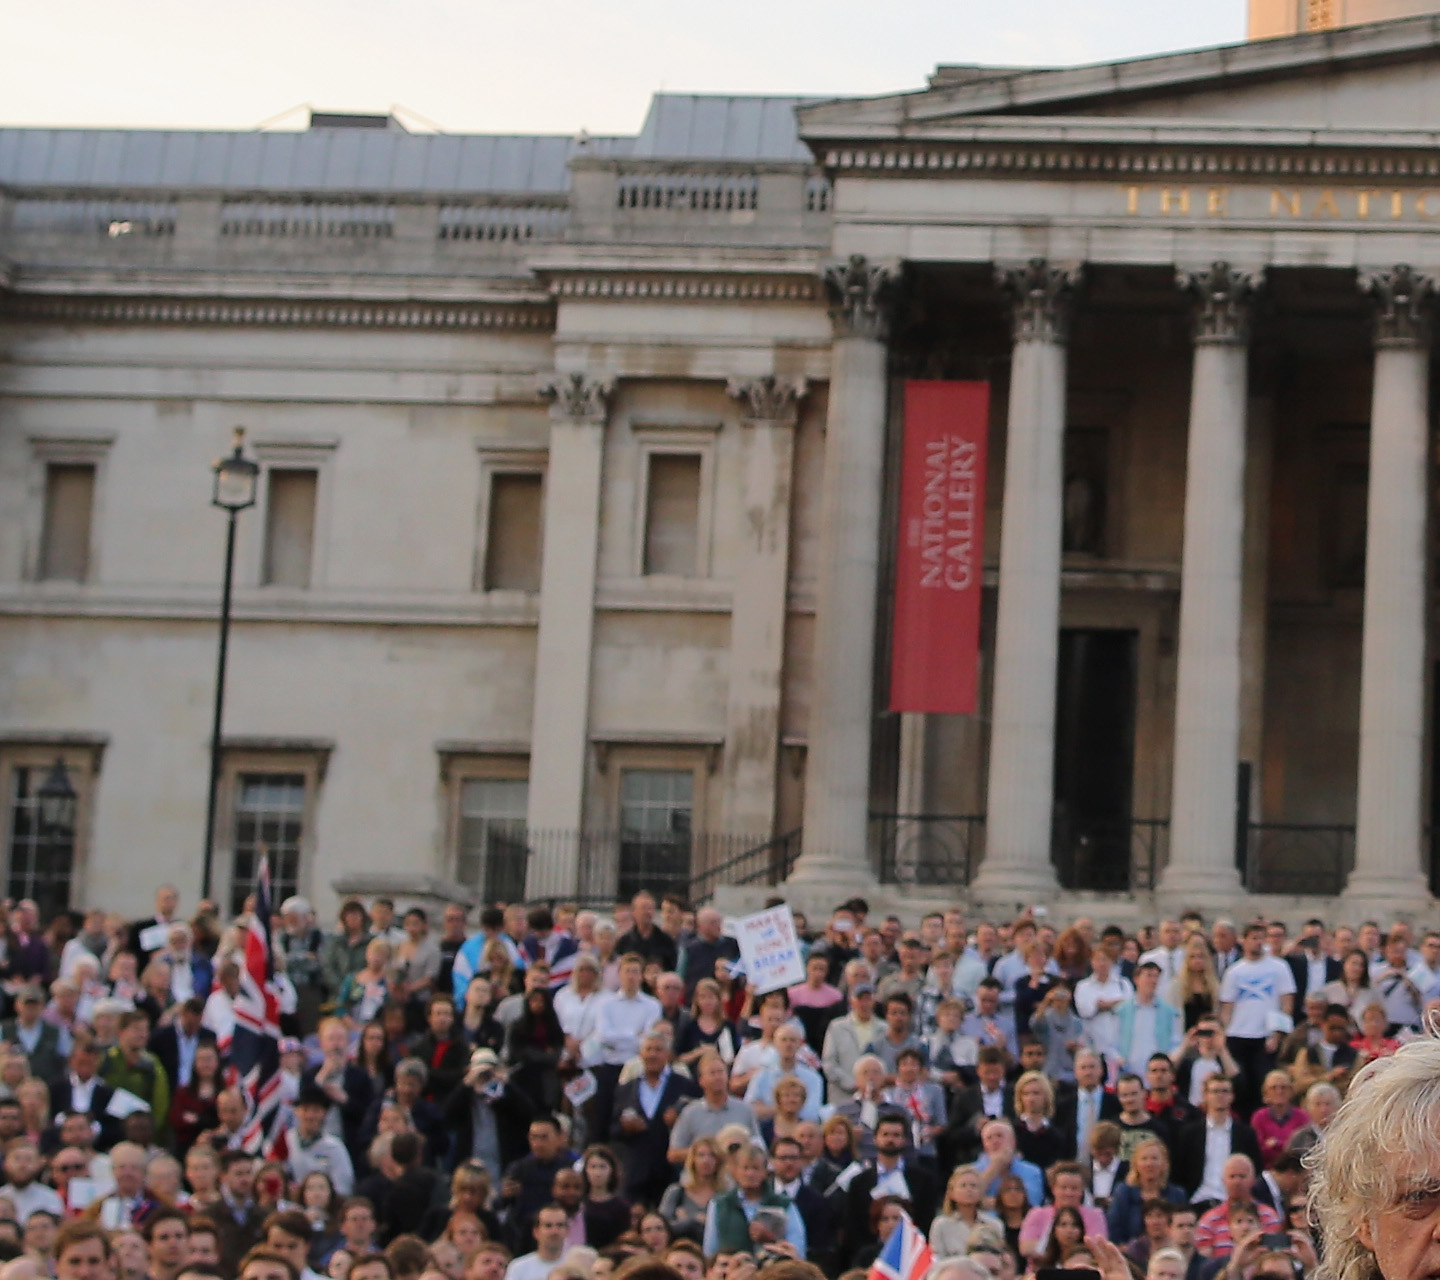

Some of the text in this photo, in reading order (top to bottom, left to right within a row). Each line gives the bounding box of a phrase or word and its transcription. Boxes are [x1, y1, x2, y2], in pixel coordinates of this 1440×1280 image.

[1116, 186, 1226, 217] THE
[920, 433, 949, 589] NATIONAL
[946, 436, 977, 591] GALLERY
